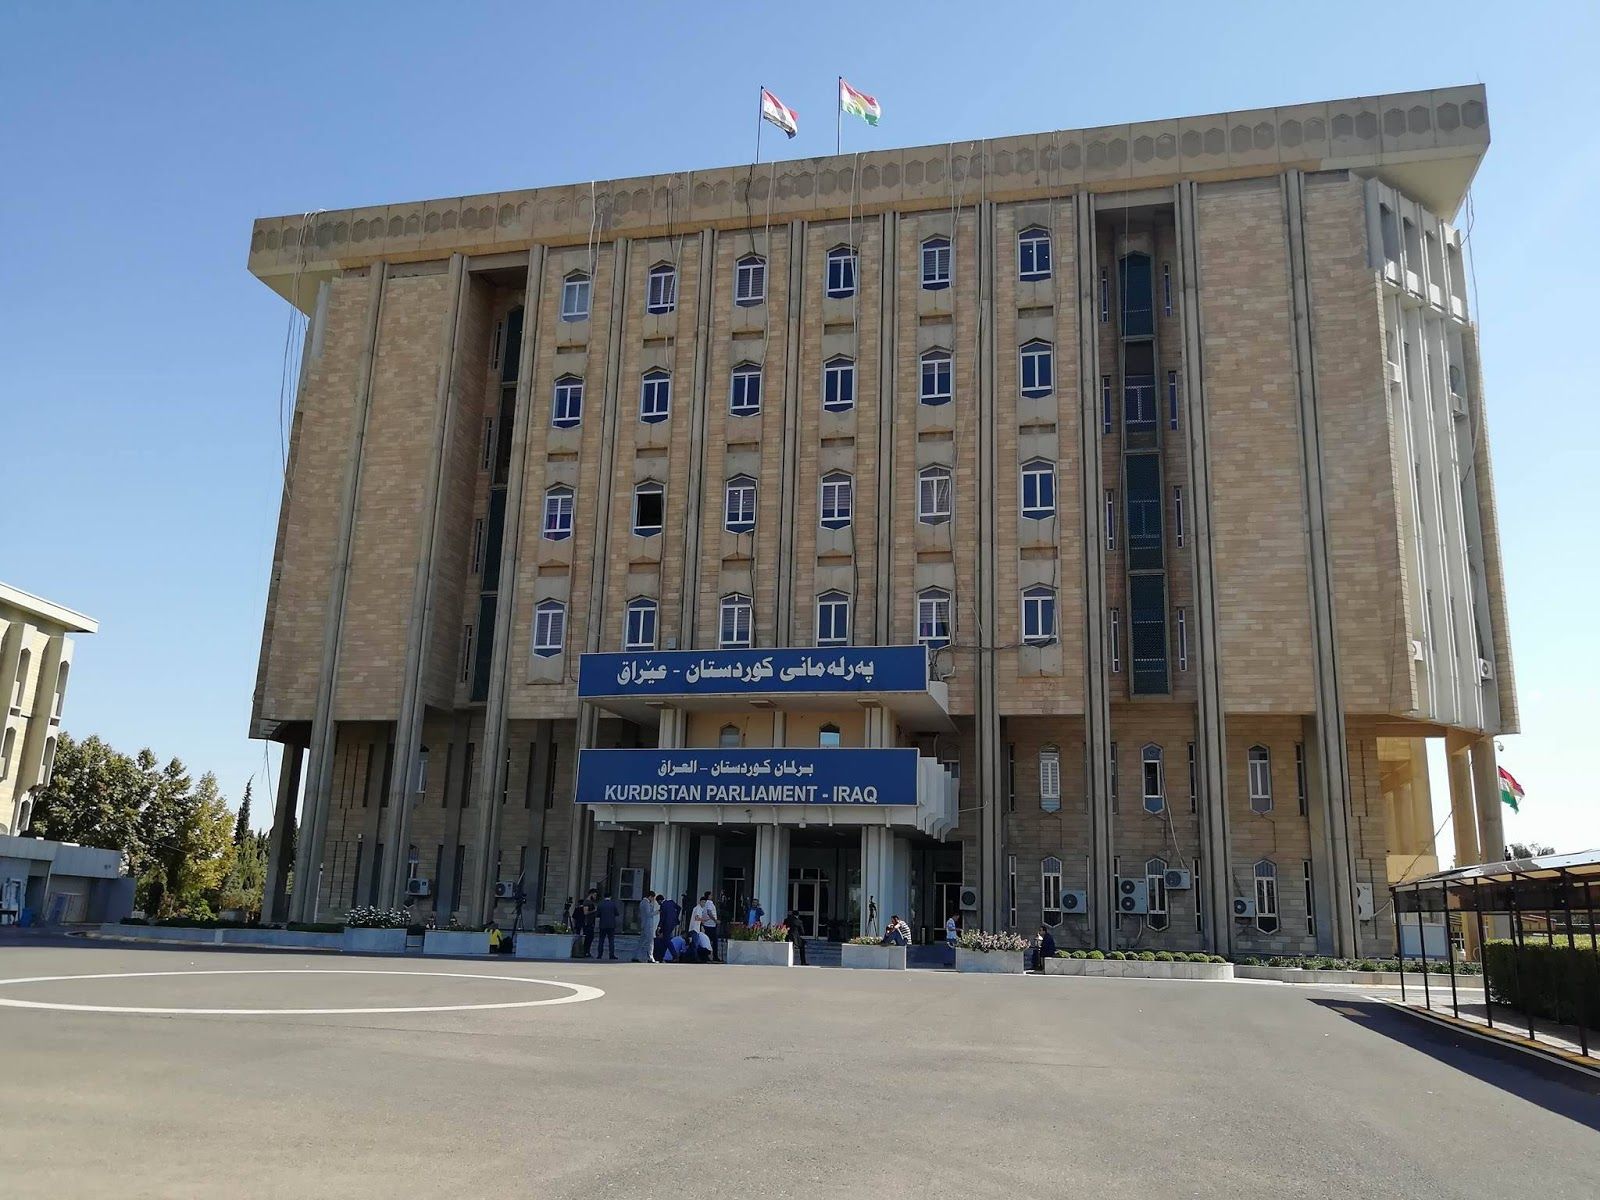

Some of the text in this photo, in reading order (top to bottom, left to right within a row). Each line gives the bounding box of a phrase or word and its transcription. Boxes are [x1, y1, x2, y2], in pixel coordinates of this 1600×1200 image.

[657, 759, 698, 777] العراق
[774, 759, 814, 777] برلمان
[604, 784, 701, 801] KURDISTAN
[706, 785, 818, 802] PARLIAMENT
[833, 785, 878, 804] IRAQ
